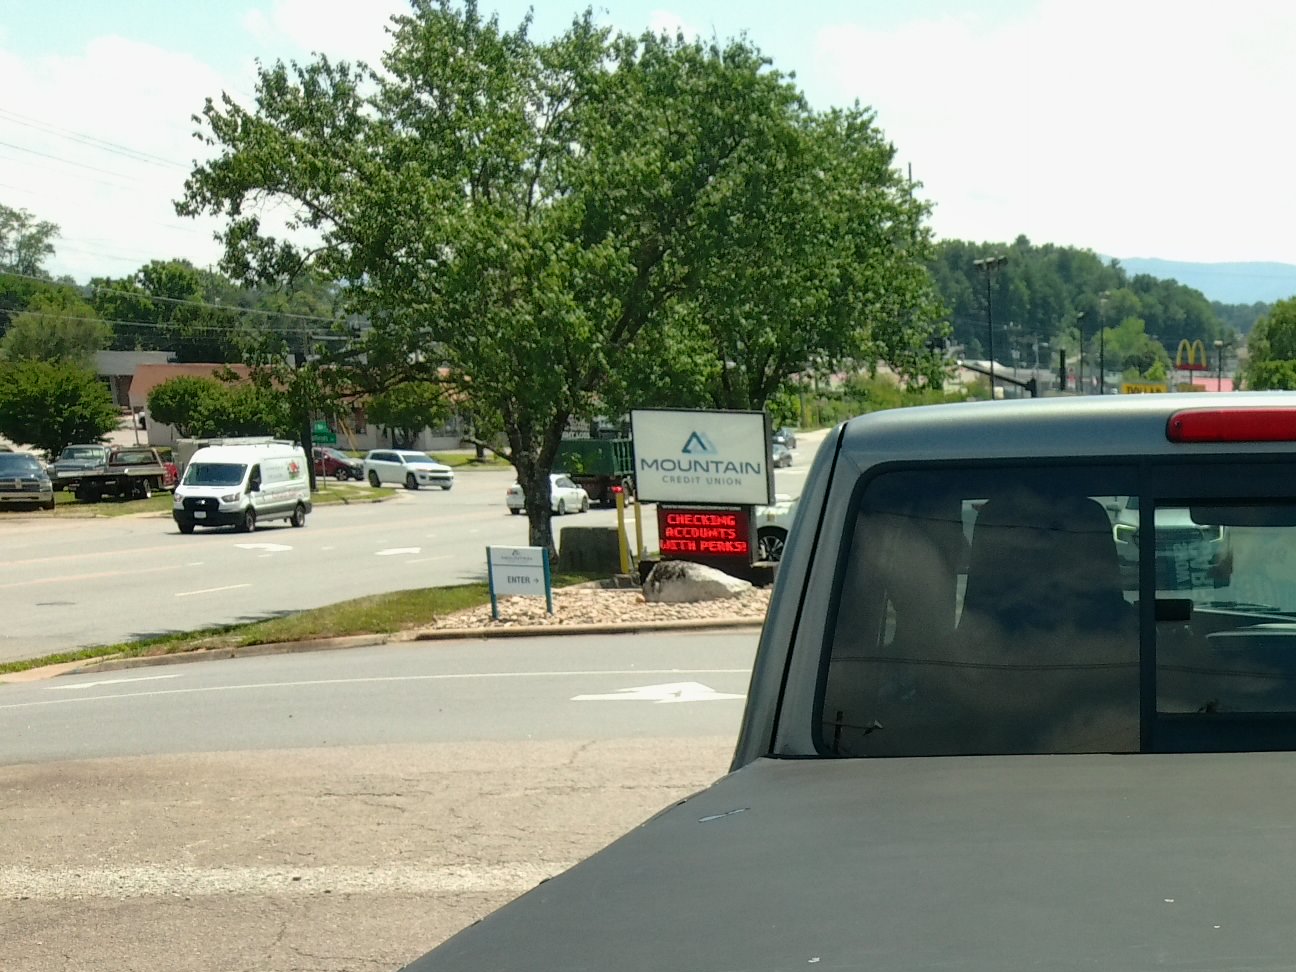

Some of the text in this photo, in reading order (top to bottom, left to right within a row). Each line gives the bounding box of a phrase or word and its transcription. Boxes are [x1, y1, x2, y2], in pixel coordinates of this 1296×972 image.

[641, 458, 761, 475] MOUNTAIN
[662, 475, 742, 486] CREDIT UNION
[667, 513, 736, 526] CHECKING
[665, 527, 737, 539] ACCOUNTS
[660, 539, 747, 552] WITH PERKS!
[507, 575, 531, 584] ENTER
